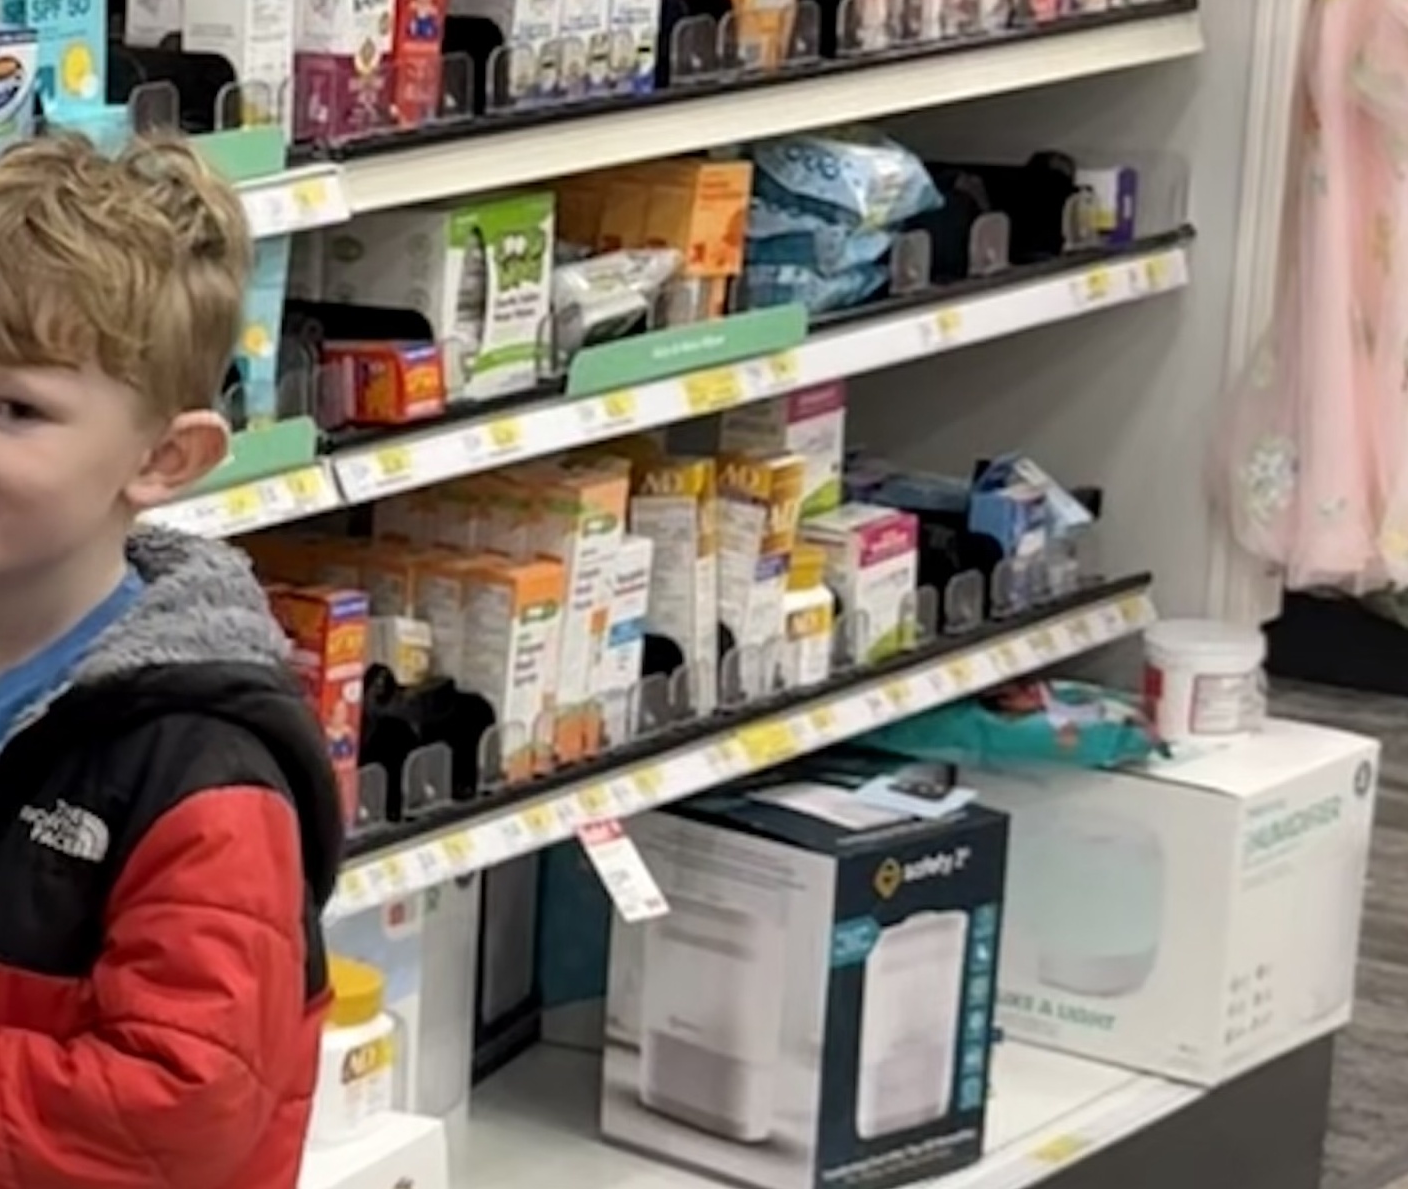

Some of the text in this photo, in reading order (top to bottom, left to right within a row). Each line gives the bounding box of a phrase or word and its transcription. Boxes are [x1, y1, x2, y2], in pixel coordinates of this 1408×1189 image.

[20, 805, 81, 838] NORTH
[29, 828, 87, 857] FACE
[903, 852, 951, 882] safety
